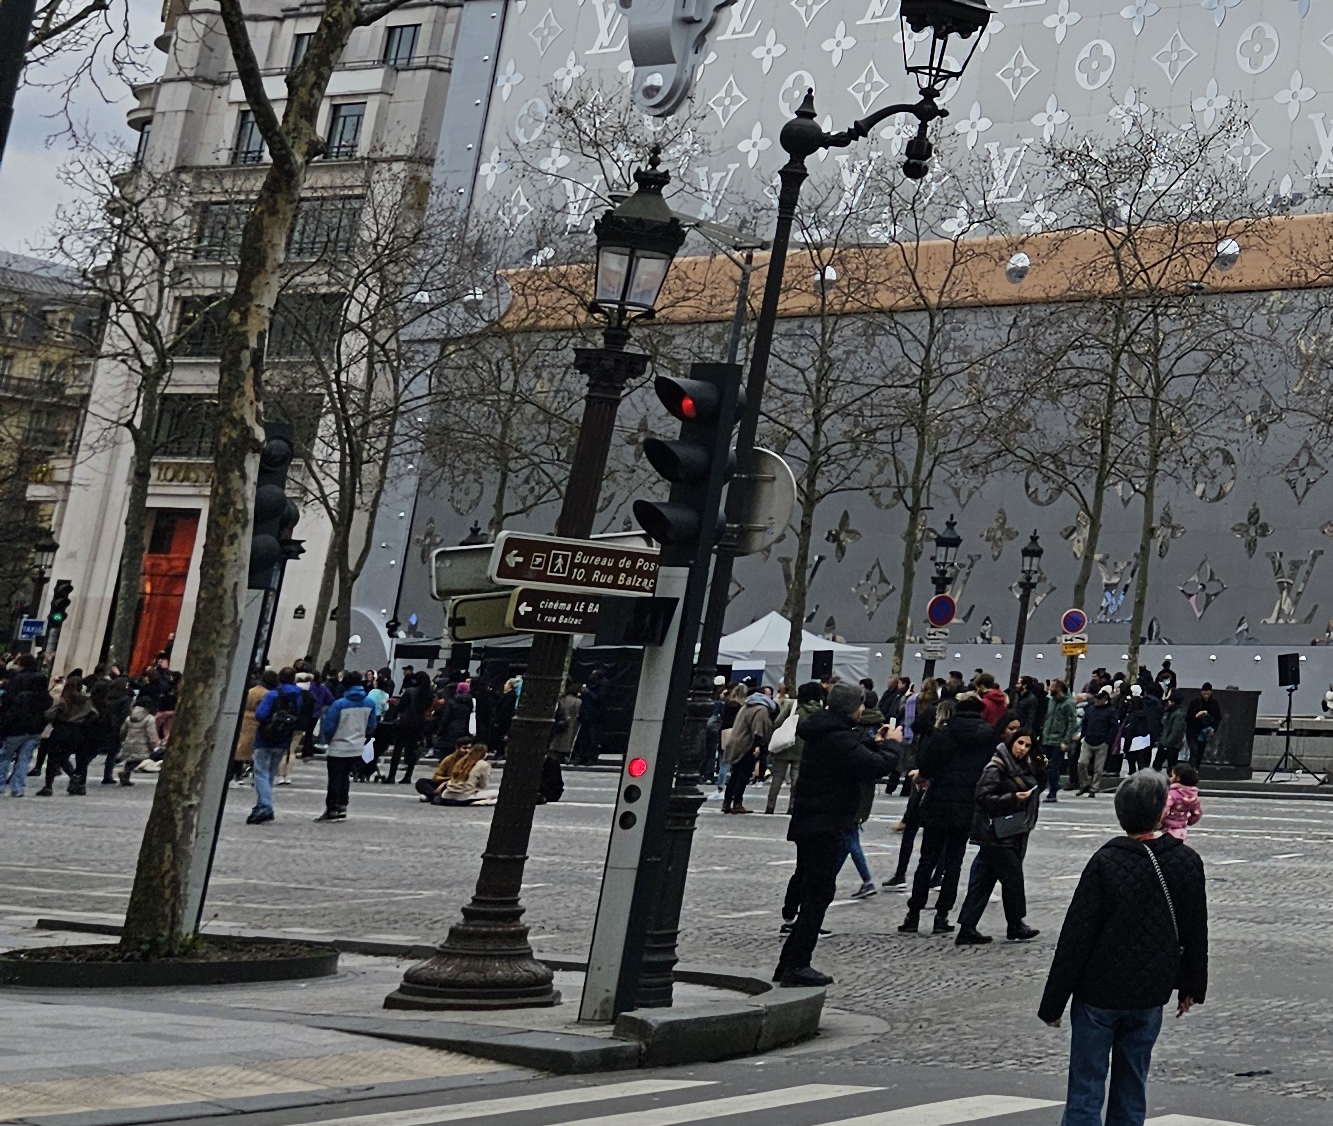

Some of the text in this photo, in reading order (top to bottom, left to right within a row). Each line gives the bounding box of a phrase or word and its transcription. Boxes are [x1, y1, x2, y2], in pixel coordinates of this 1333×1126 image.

[574, 551, 615, 567] Bureau
[618, 557, 632, 568] de
[571, 568, 655, 588] 10, Rue Balzac
[539, 599, 571, 611] cinéma
[574, 601, 585, 612] LE
[544, 615, 557, 624] rue
[558, 616, 583, 625] Balzac
